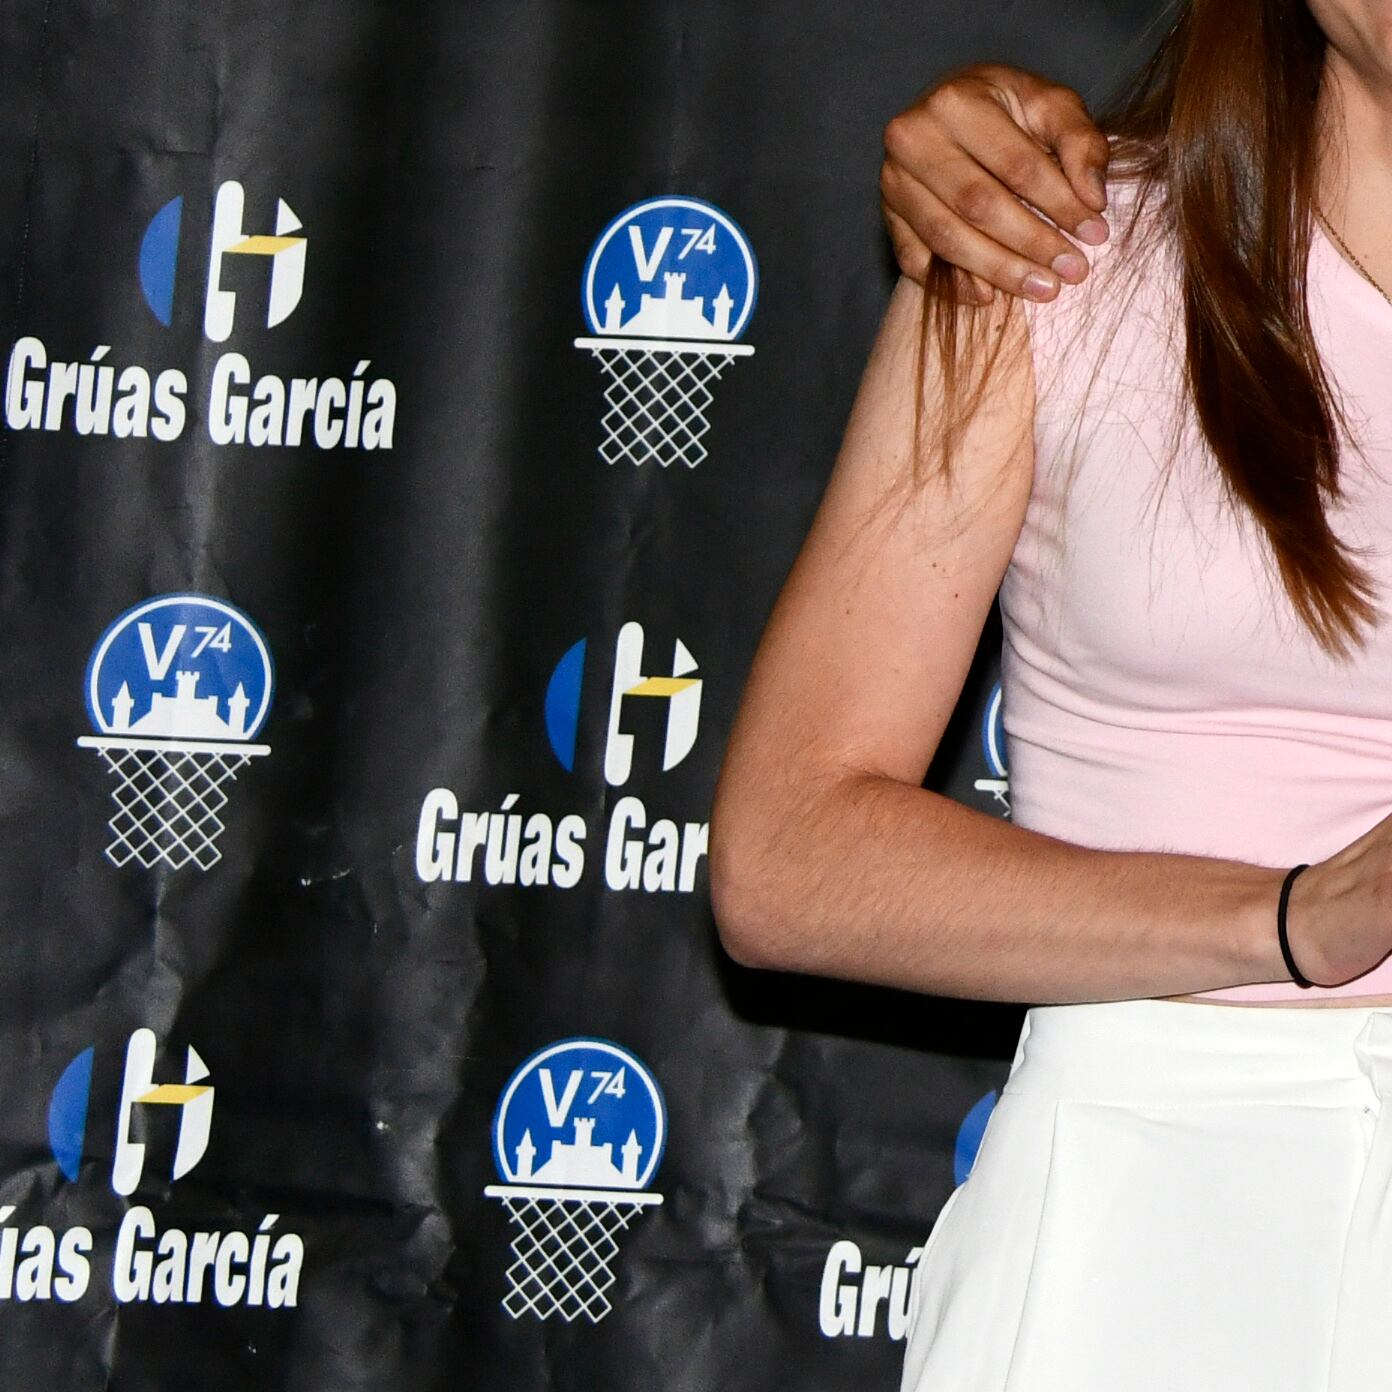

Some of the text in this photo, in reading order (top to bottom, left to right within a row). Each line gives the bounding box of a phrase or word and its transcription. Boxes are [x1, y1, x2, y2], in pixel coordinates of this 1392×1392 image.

[6, 336, 397, 451] Grúas García
[415, 787, 710, 892] Grúas Gar
[112, 1206, 304, 1308] García
[819, 1240, 924, 1341] Grú
